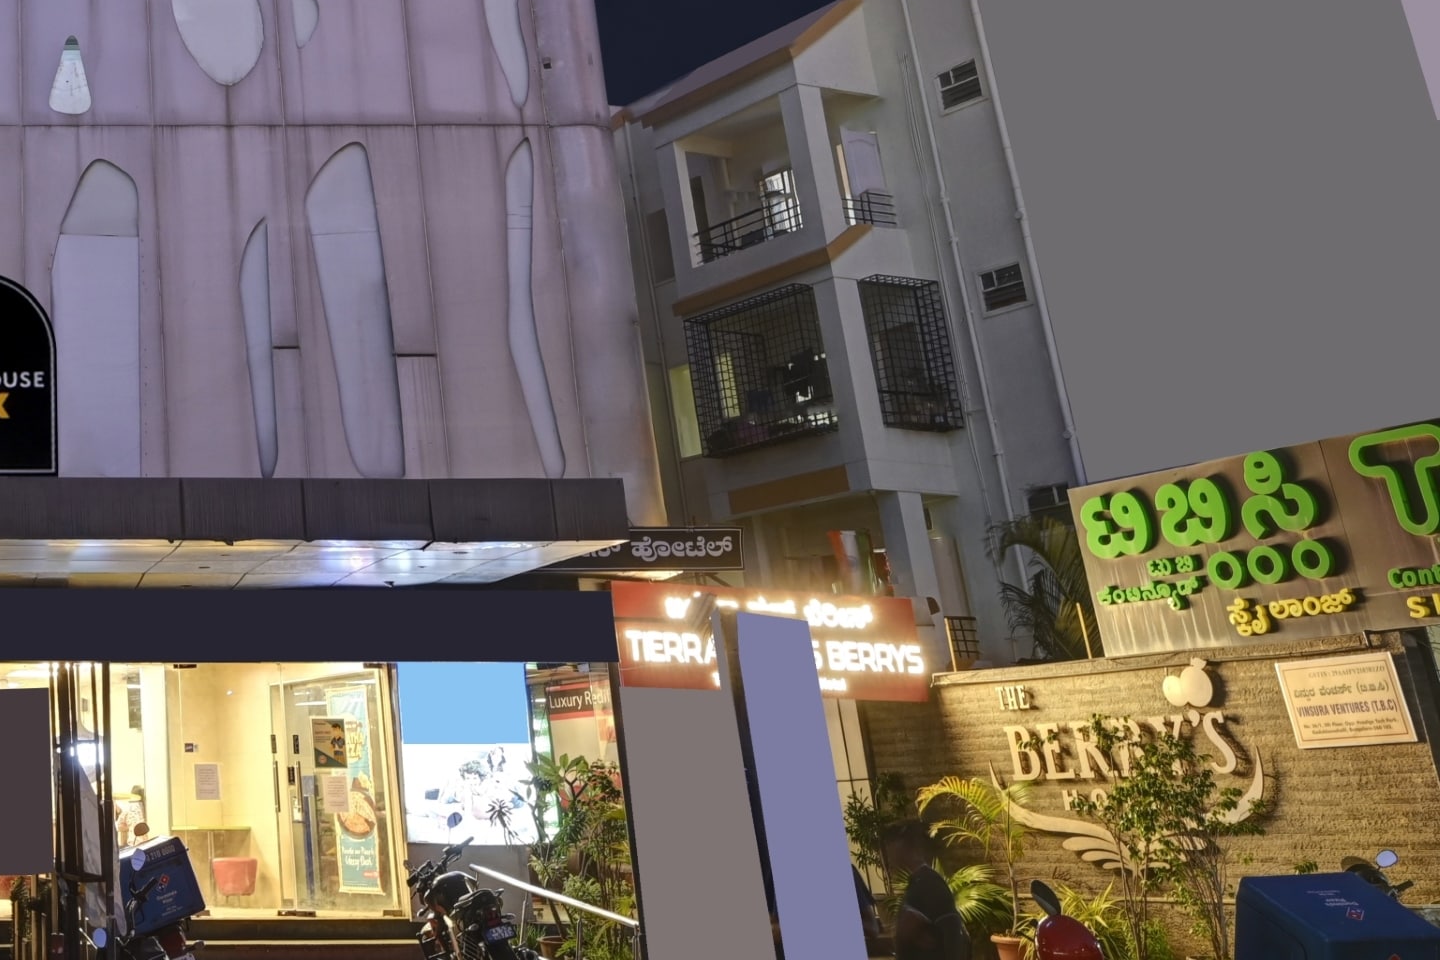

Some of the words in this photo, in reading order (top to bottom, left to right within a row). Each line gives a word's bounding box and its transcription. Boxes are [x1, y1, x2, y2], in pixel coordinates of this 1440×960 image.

[631, 536, 733, 562] ಹೋಟೆಲ್
[825, 641, 925, 674] BERRYS
[549, 695, 582, 710] Luxury
[995, 684, 1031, 711] THE
[1296, 704, 1330, 718] VINSURA
[1330, 701, 1370, 715] VENTURES
[1371, 698, 1398, 714] (T.B.C)
